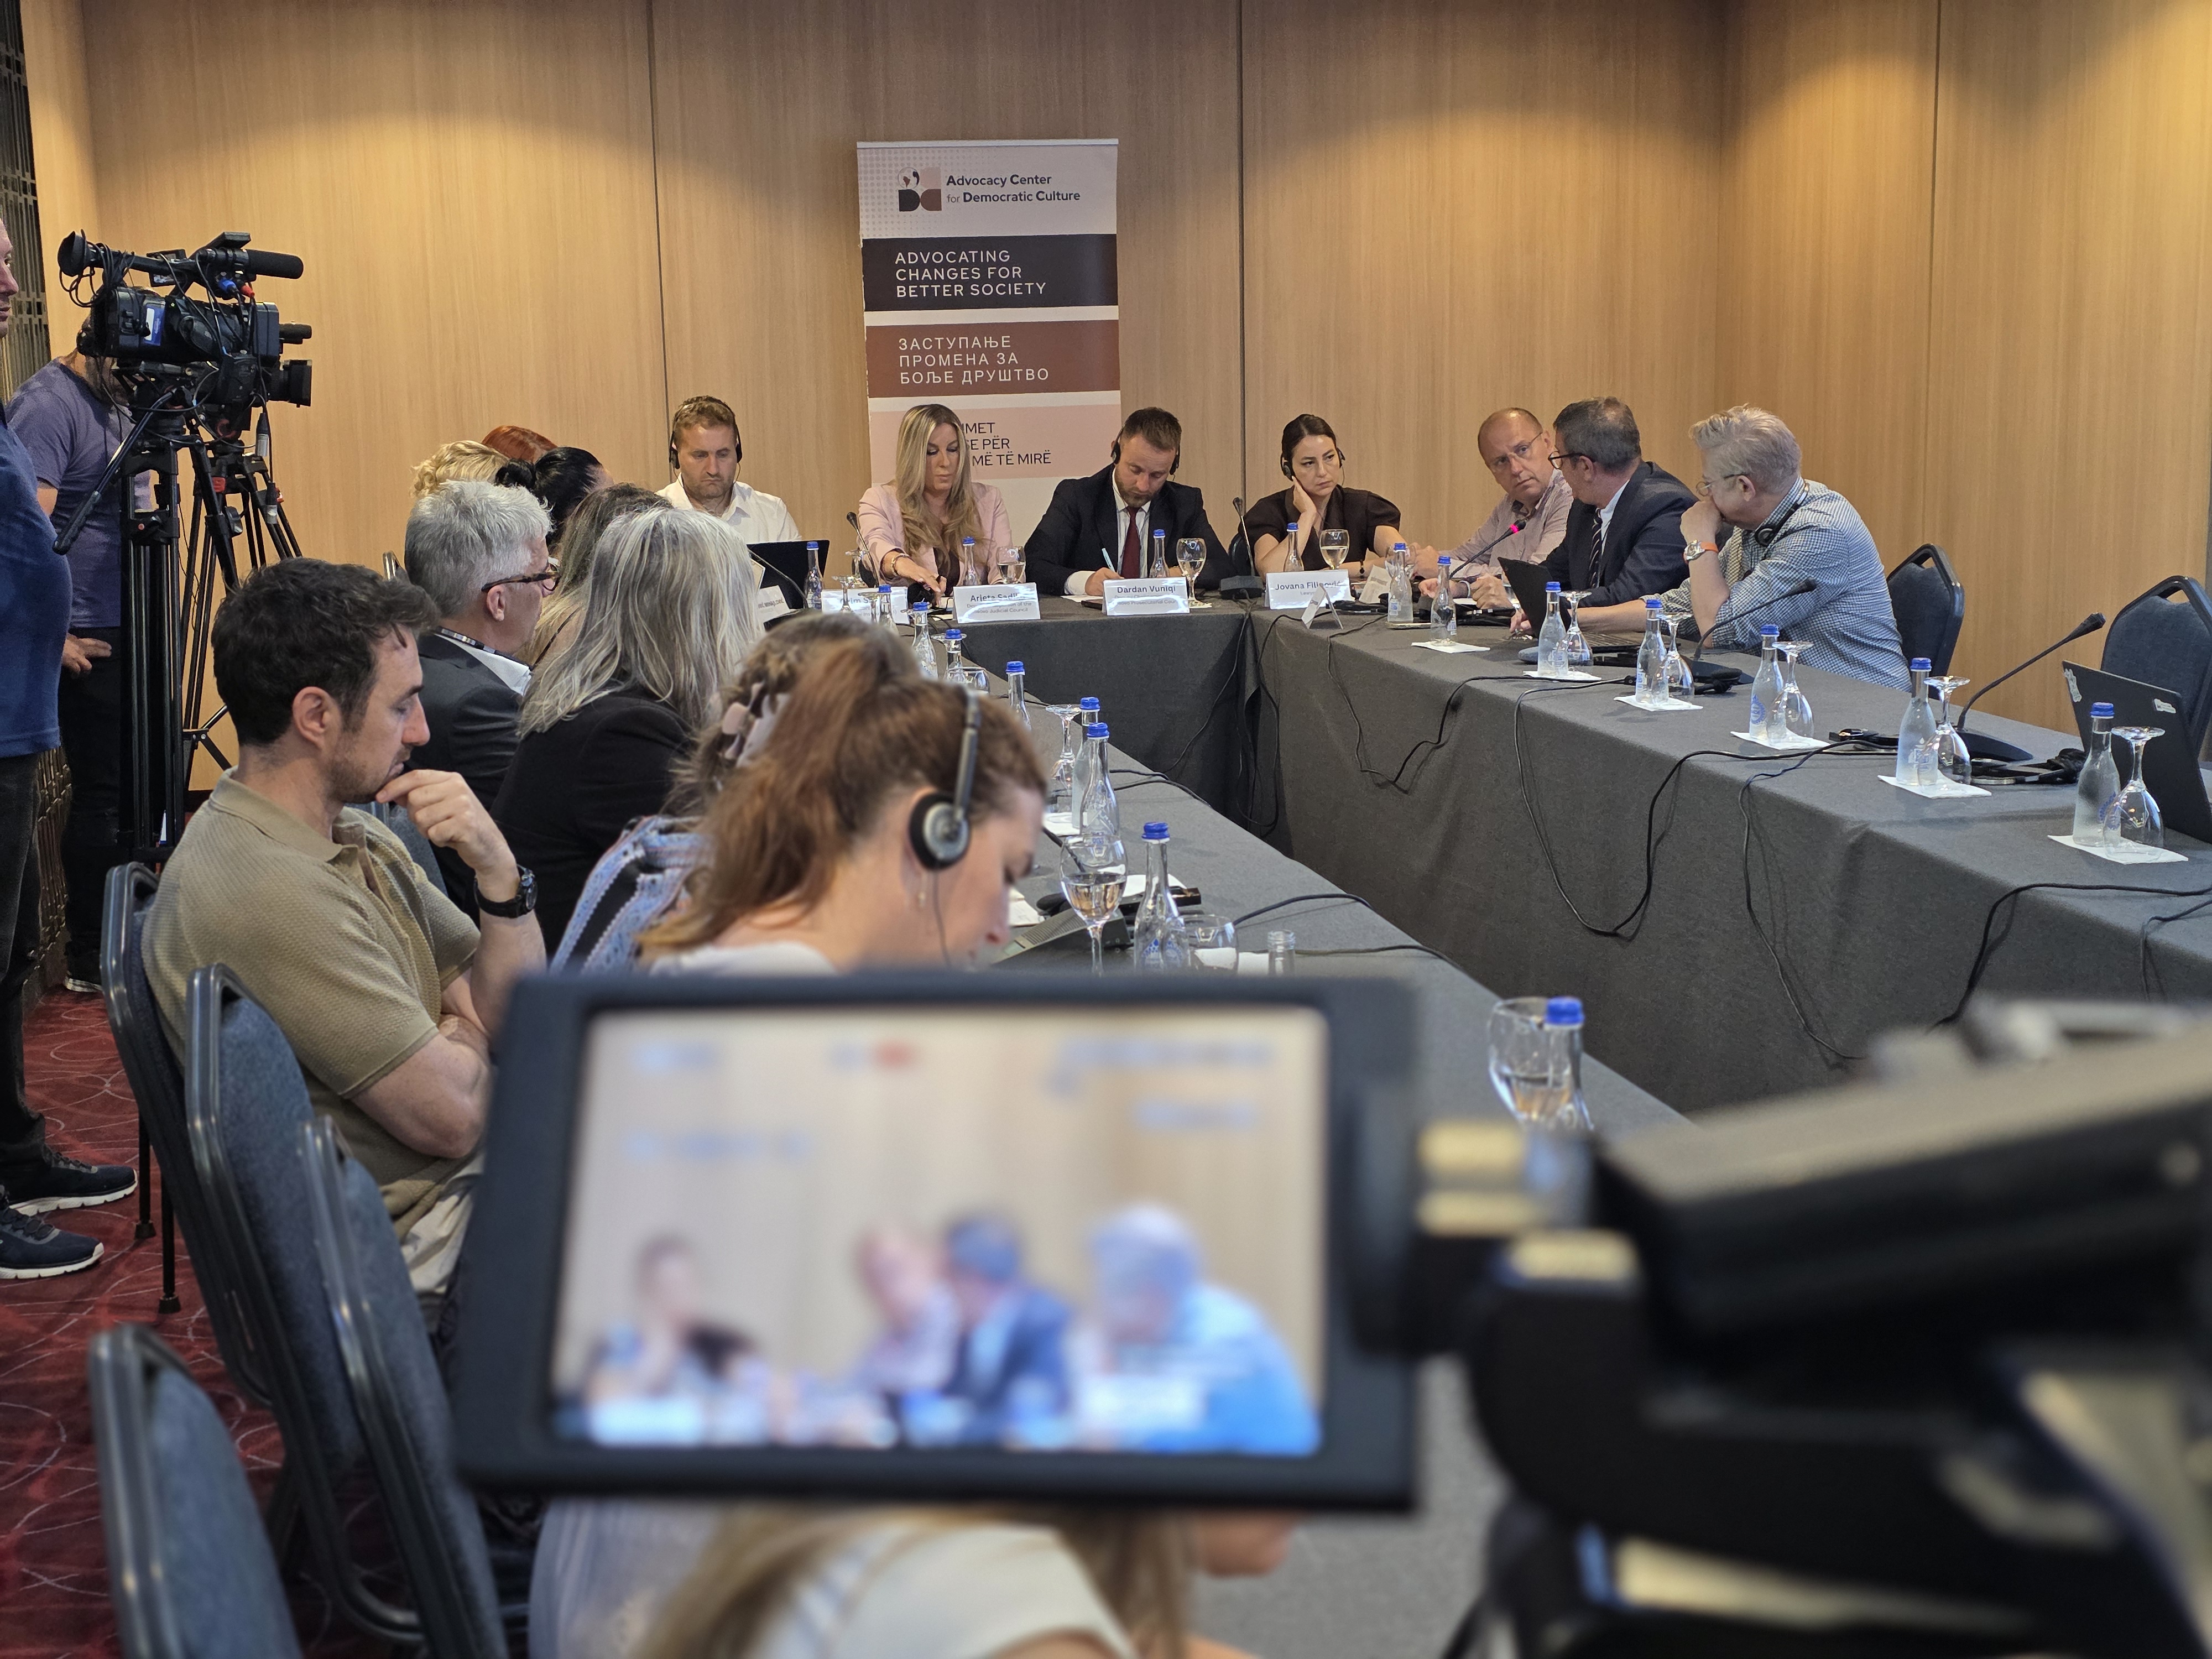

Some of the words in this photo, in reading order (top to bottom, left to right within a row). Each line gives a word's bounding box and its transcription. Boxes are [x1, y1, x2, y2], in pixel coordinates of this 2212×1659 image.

[946, 175, 1006, 187] Advocacy
[1010, 174, 1052, 185] Center
[947, 194, 960, 204] for
[963, 191, 1033, 203] Democratic
[1036, 190, 1081, 201] Culture
[895, 250, 1010, 264] ADVOCATING
[895, 268, 981, 281] CHANGES
[988, 267, 1021, 279] FOR
[897, 284, 964, 298] BETTER
[971, 282, 1047, 295] SOCIETY
[899, 336, 1011, 351] ЗАСТУПАЊЕ
[899, 353, 989, 367] ПРОМЕНА
[997, 352, 1019, 364] ЗА
[900, 371, 954, 384] БОЉЕ
[962, 368, 1048, 385] ДРУШТВО
[983, 435, 1010, 450] PËR
[973, 451, 993, 466] MË
[996, 451, 1014, 466] TË
[1018, 450, 1051, 465] MIRË
